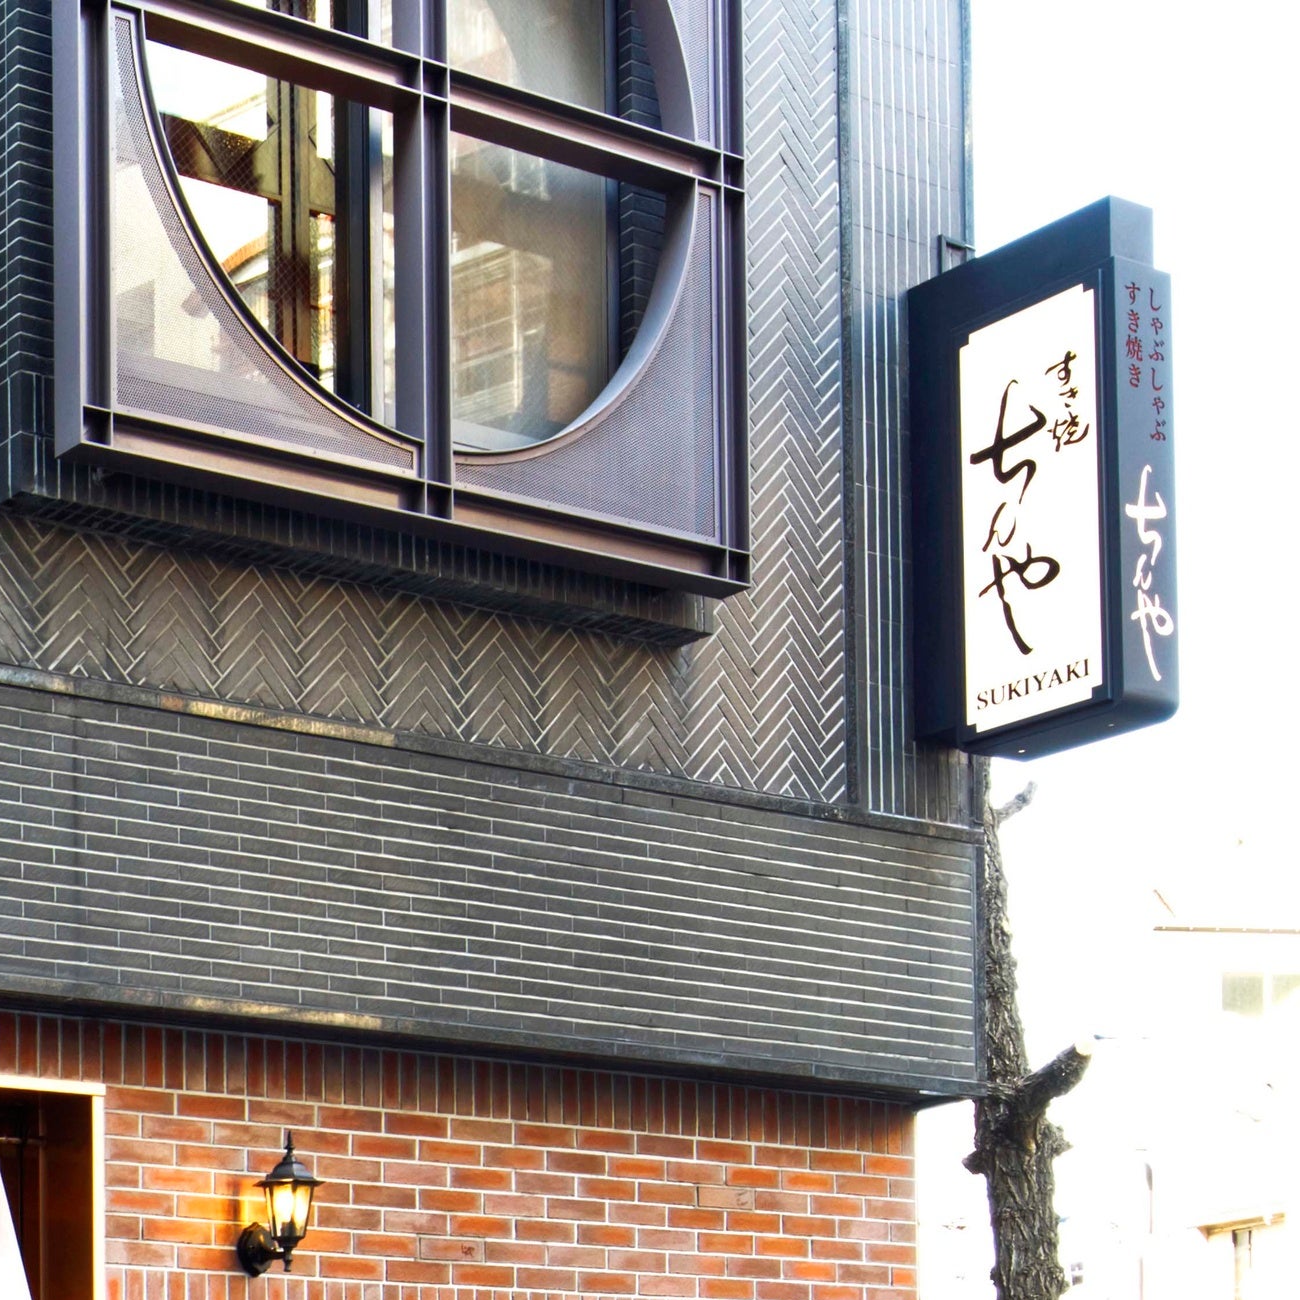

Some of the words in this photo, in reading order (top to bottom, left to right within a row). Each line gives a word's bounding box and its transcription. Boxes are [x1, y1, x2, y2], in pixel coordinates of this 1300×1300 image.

[1124, 281, 1144, 388] すき焼き
[1148, 288, 1167, 442] しゃぶしゃぶ
[970, 379, 1061, 655] ちんや
[1125, 463, 1174, 682] ちんや
[976, 658, 1090, 711] SUKIYAKI
